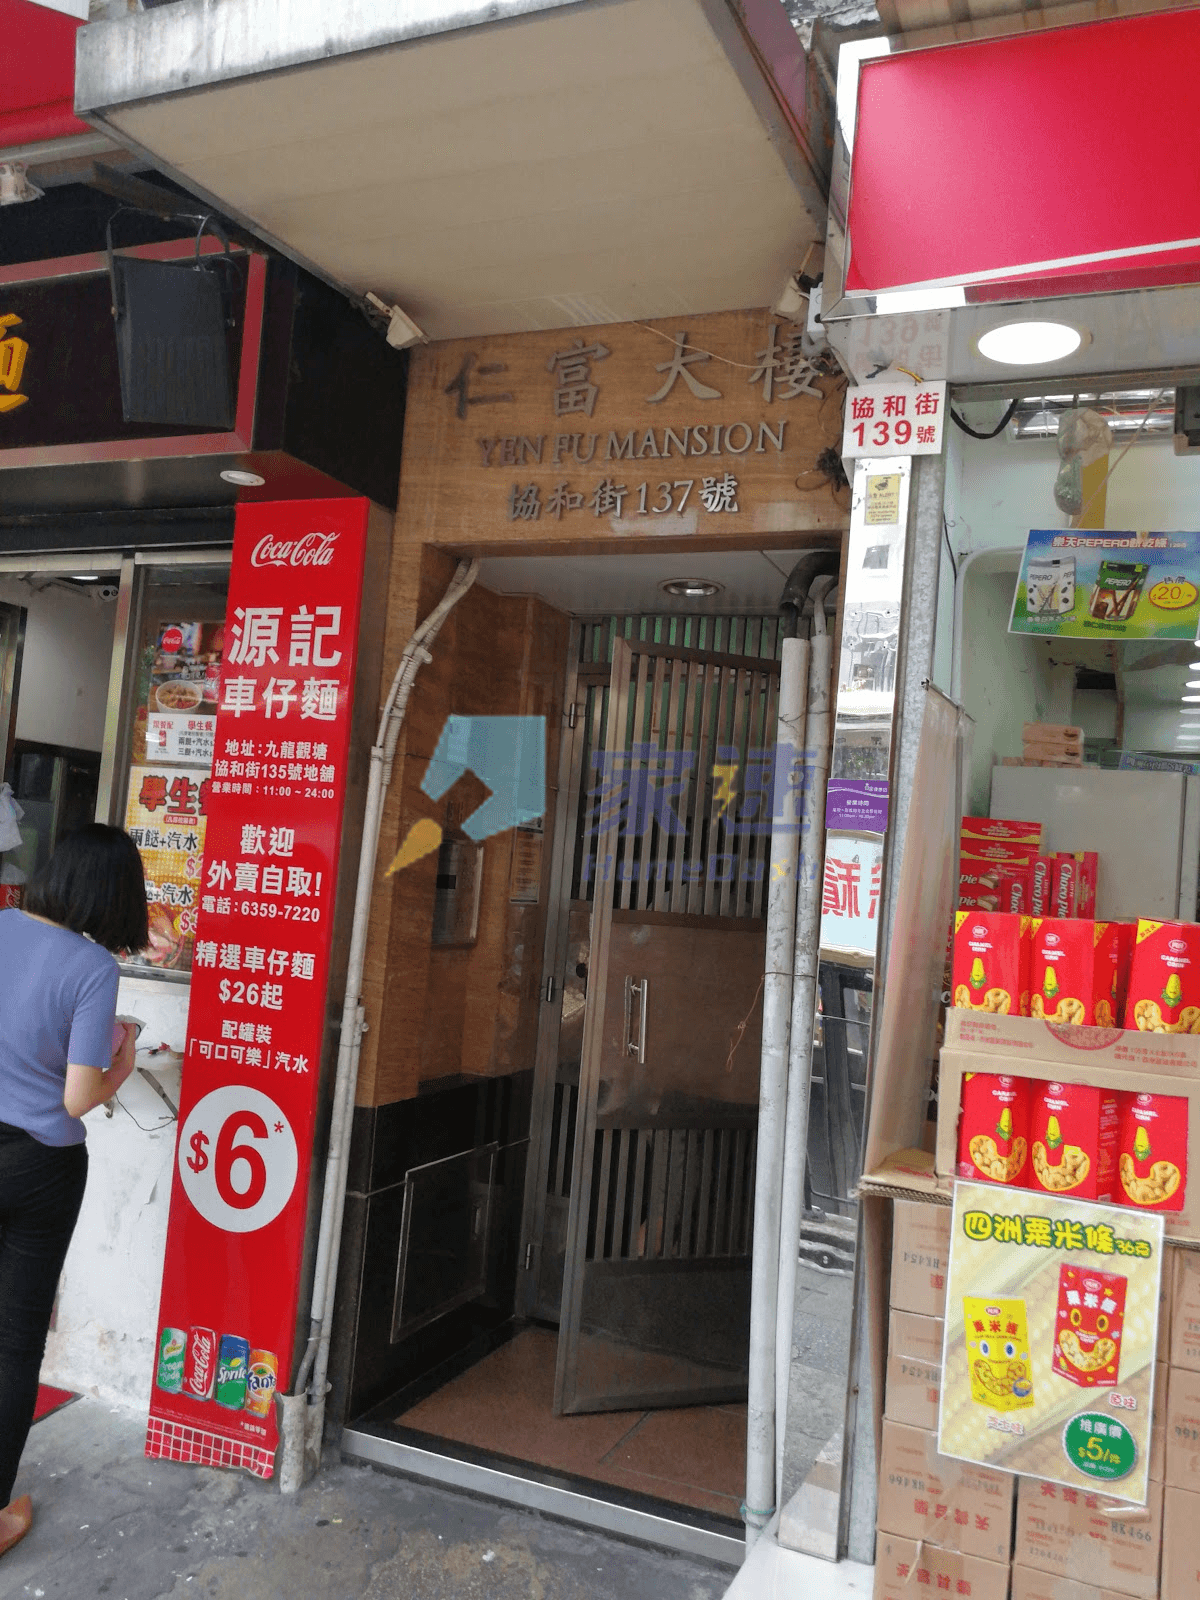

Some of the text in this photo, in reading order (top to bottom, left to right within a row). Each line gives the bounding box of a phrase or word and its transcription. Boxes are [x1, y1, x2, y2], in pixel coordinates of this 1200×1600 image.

[444, 323, 824, 420] 仁富大樓
[851, 393, 940, 419] 協和街
[478, 420, 788, 467] YEN FU MANSION
[852, 419, 936, 447] 139號
[508, 473, 739, 521] 協和街137號
[251, 532, 341, 568] Coca-Cola
[228, 604, 342, 668] 源記
[220, 675, 340, 721] 車仔麵
[214, 759, 335, 783] 協和街135號地舖
[304, 787, 335, 799] 24:00
[240, 823, 295, 857] 歡迎
[206, 859, 323, 898] 外賣自取!
[195, 939, 317, 981] 精選車仔麵
[218, 978, 283, 1011] $26起
[221, 1019, 273, 1045] 配罐裝
[219, 1366, 248, 1384] Sprite
